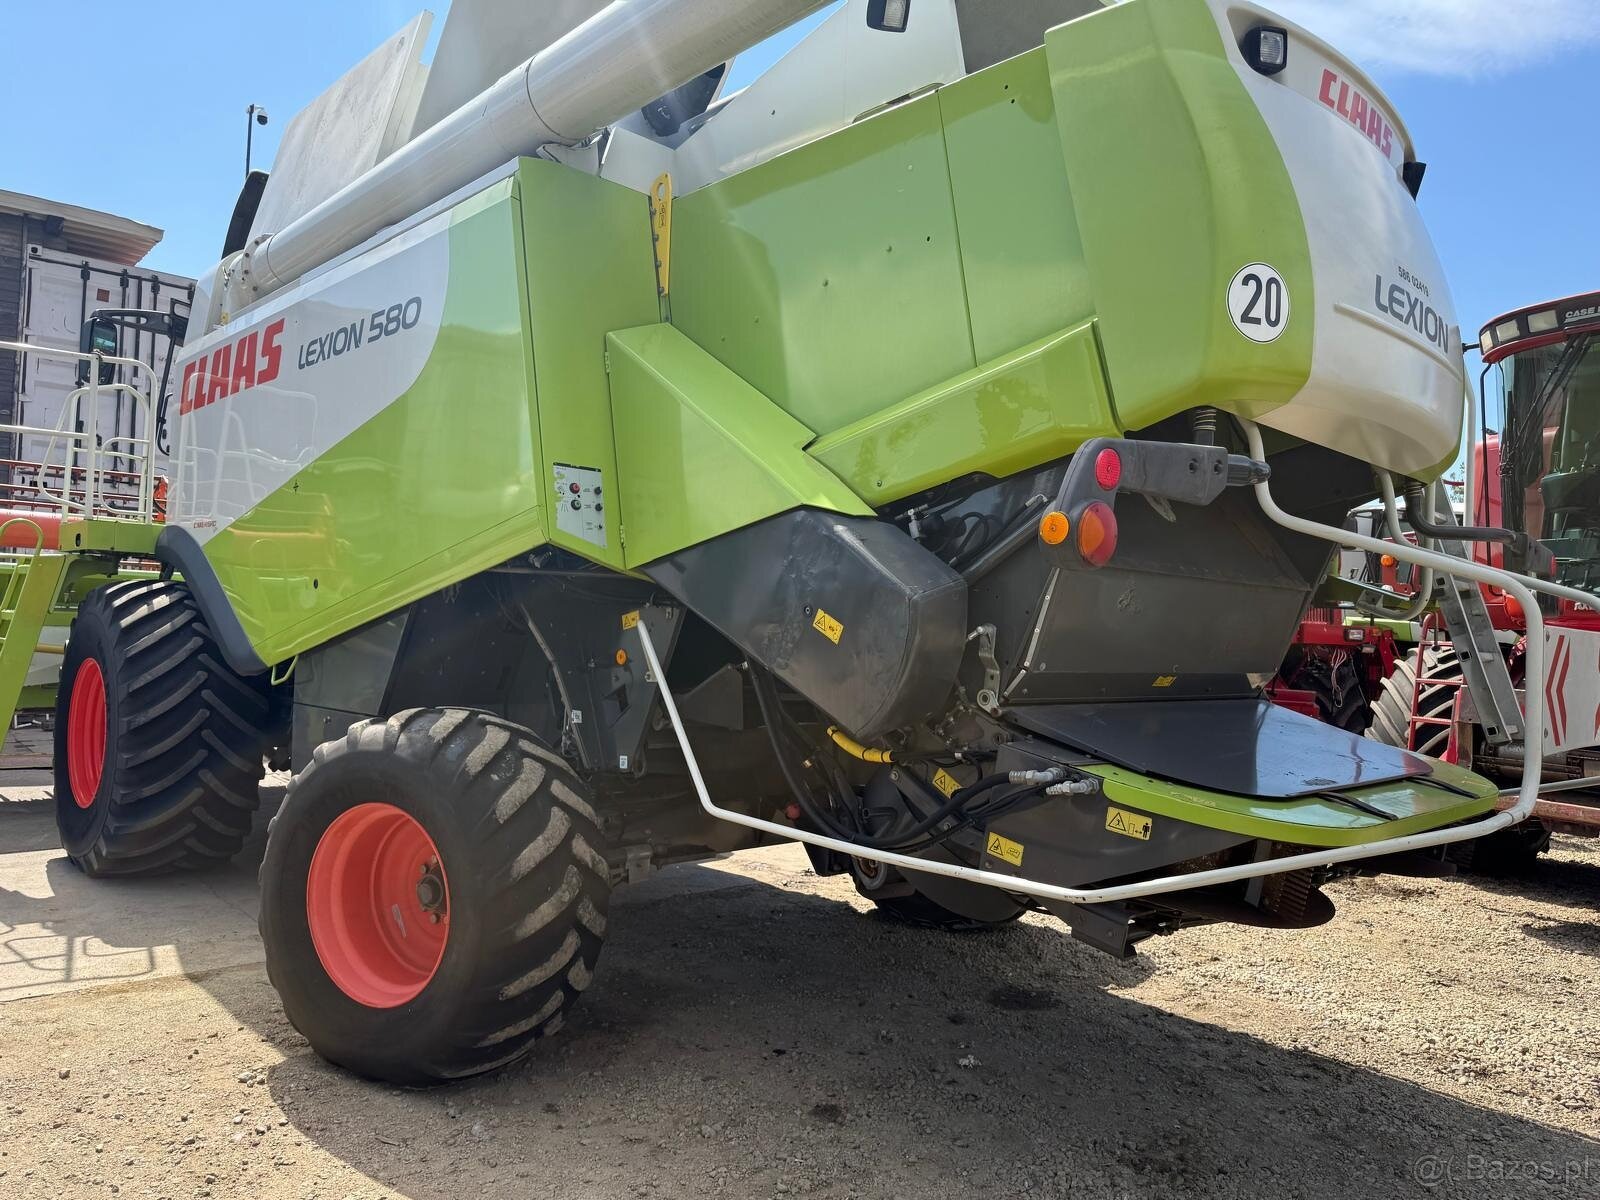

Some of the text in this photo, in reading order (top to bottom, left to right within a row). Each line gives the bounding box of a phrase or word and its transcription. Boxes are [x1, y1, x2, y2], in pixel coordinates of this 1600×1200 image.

[1319, 69, 1393, 160] CLAAS
[298, 297, 423, 370] LEXION 580
[1240, 273, 1281, 328] 20
[1375, 274, 1448, 354] LEXION
[1565, 306, 1596, 318] CASE
[180, 317, 286, 416] CLAAS
